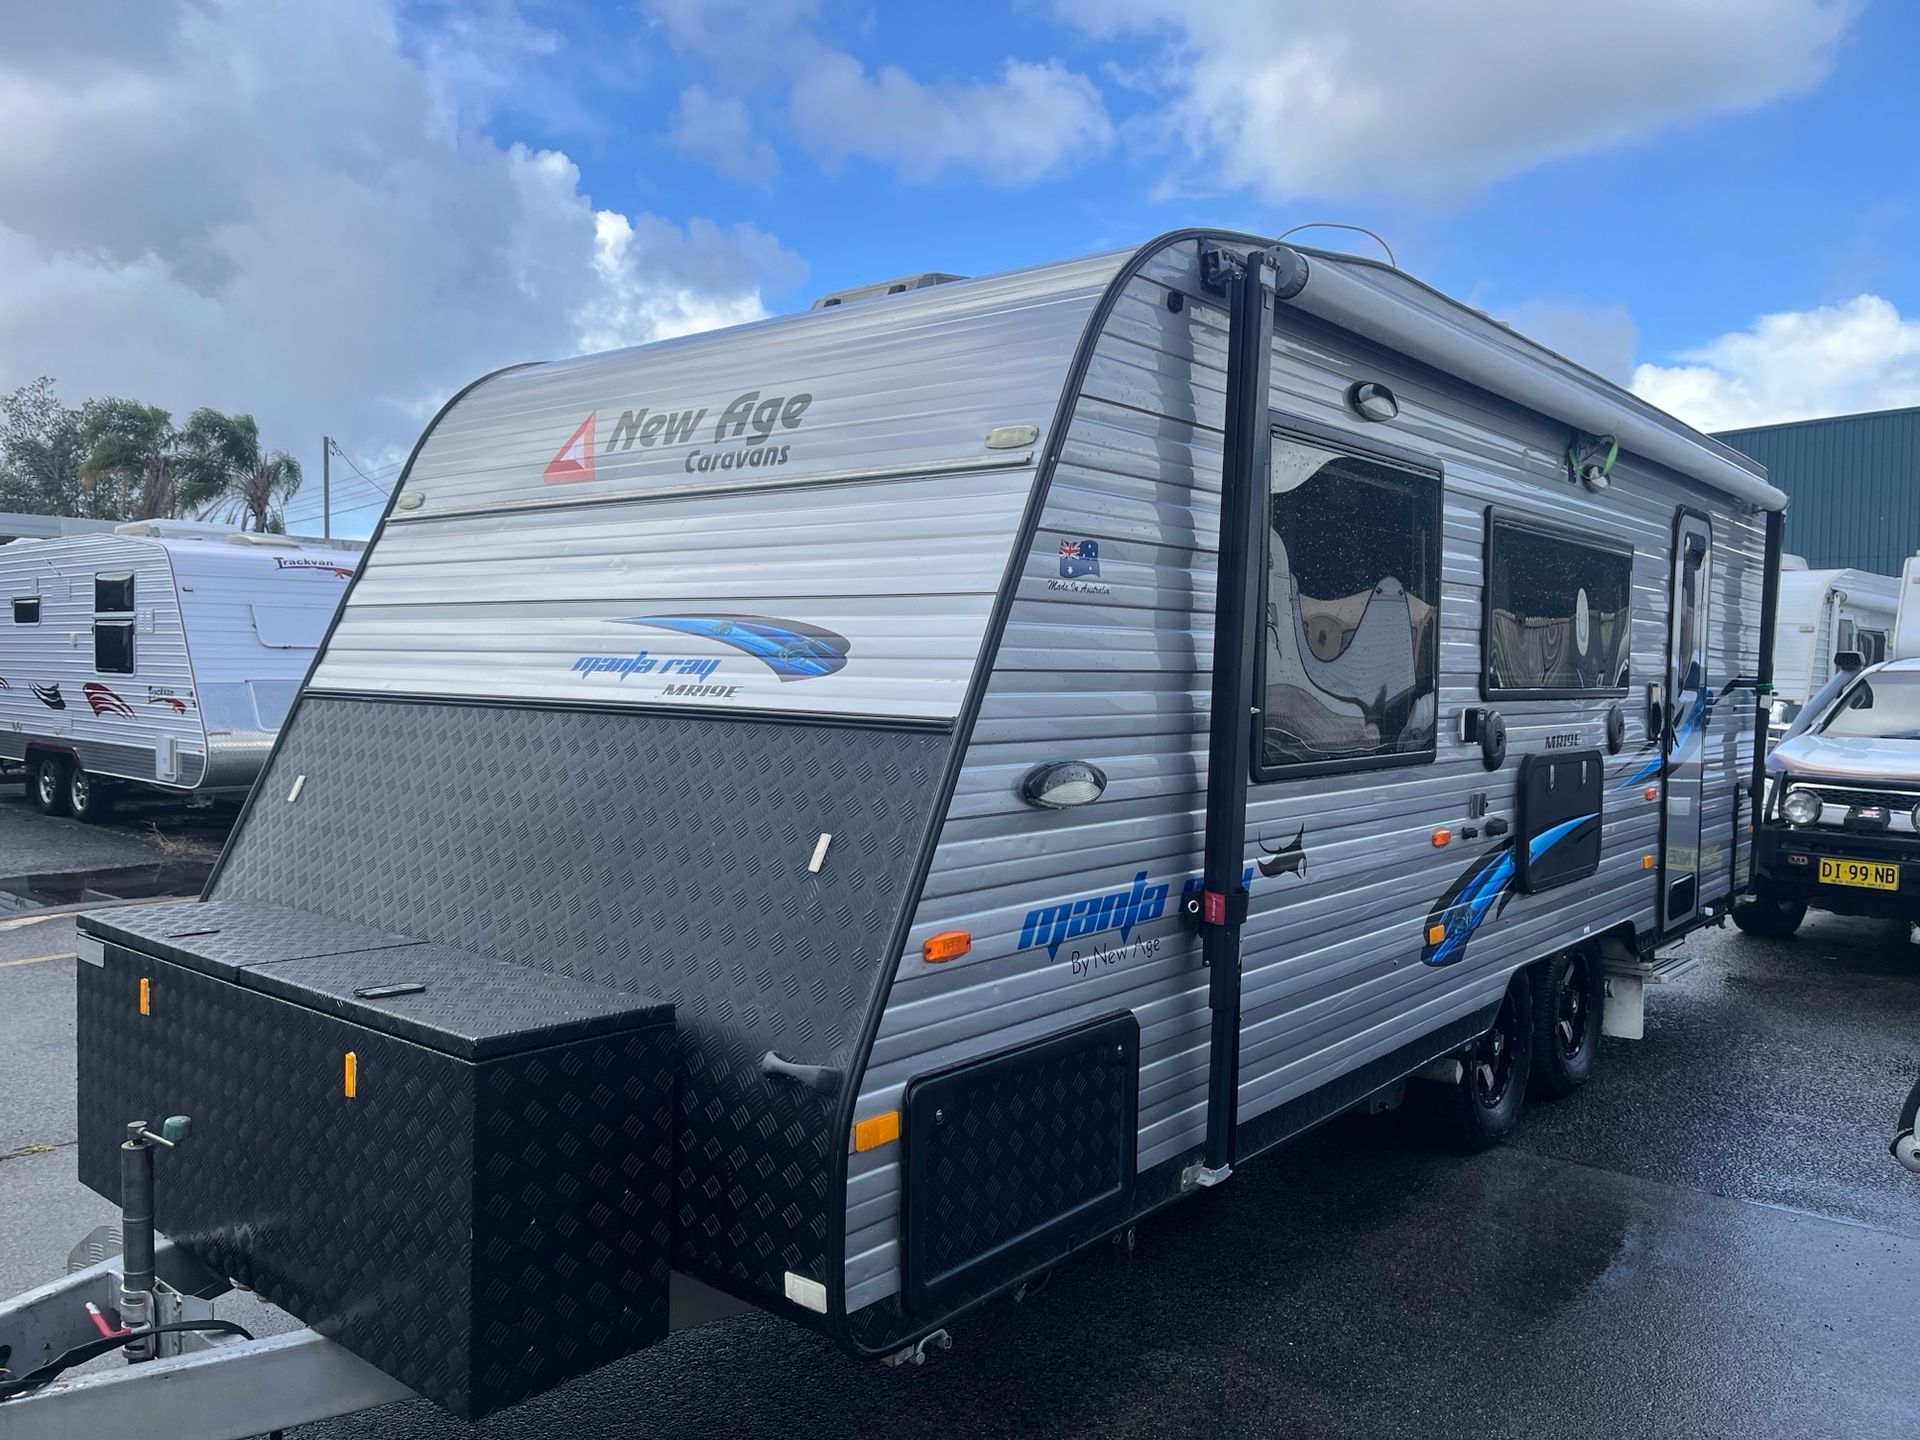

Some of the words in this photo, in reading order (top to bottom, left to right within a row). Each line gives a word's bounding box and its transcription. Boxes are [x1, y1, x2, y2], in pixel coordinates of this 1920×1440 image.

[605, 408, 708, 453] New
[714, 391, 813, 446] Age
[685, 445, 790, 473] Caravans
[273, 557, 334, 569] Trackvan
[1047, 579, 1069, 592] Made
[1079, 583, 1111, 596] Australia
[571, 651, 659, 682] manta
[658, 659, 722, 684] ray
[1822, 862, 1842, 879] DI
[1849, 864, 1868, 882] 99
[1874, 867, 1896, 884] NB
[1017, 871, 1169, 963] manta
[1071, 950, 1090, 978] By
[1093, 941, 1127, 969] New
[1133, 934, 1161, 959] Age
